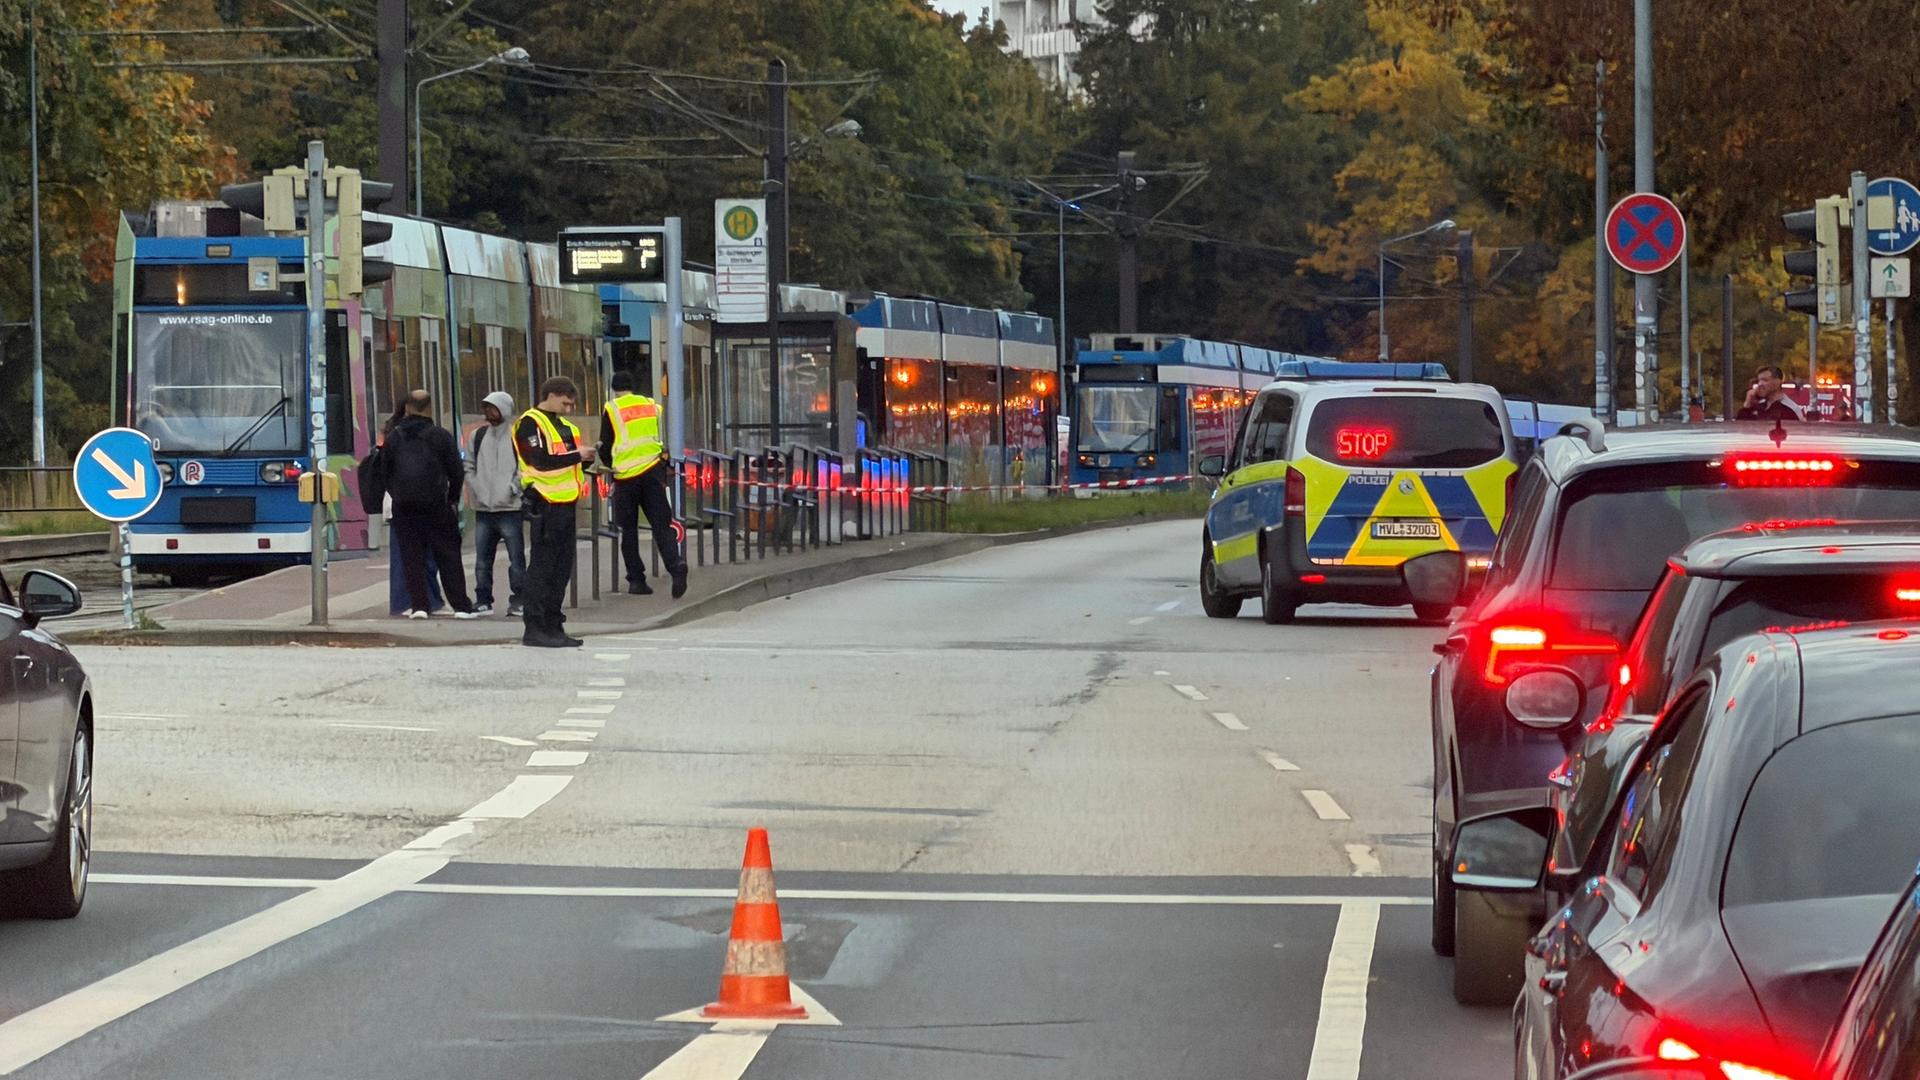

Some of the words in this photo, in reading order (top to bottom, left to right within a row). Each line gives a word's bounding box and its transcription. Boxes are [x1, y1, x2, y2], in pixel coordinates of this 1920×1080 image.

[158, 314, 273, 326] www.rsag-online.de
[1338, 431, 1388, 456] STOP
[1348, 475, 1390, 486] POLIZEI
